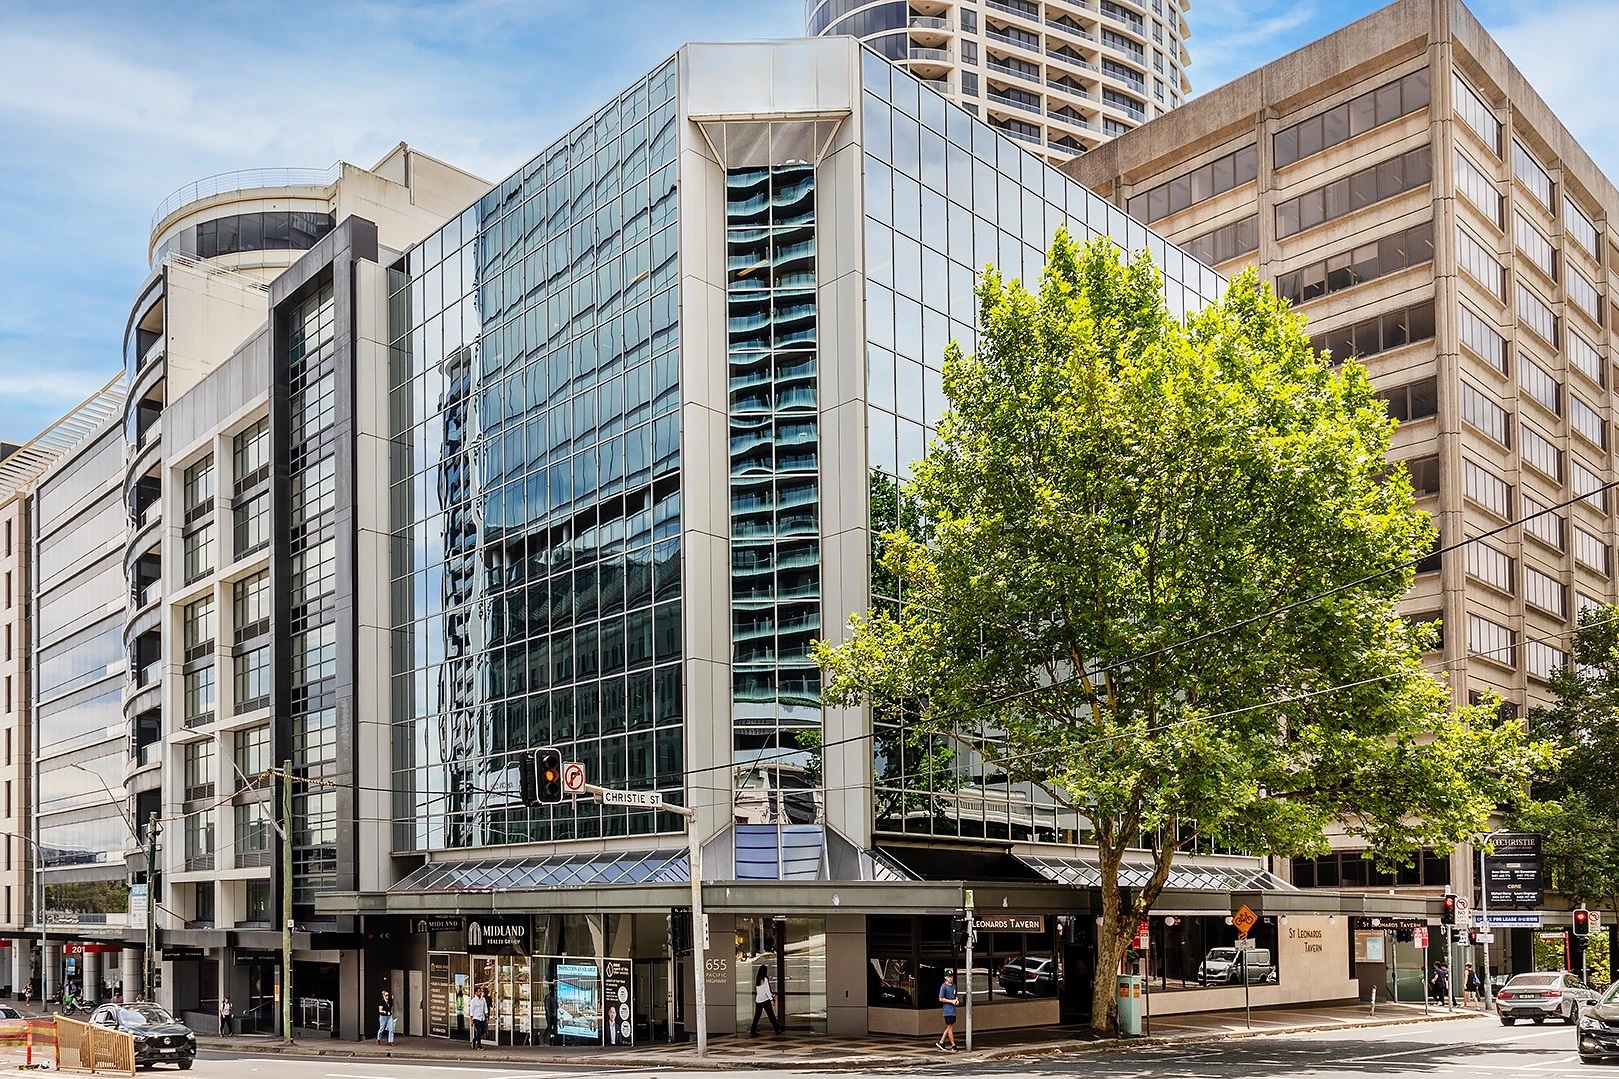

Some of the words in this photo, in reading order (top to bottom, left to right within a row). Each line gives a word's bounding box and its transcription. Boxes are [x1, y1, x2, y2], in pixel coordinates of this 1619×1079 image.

[605, 792, 646, 804] CHRISTIE
[650, 795, 660, 804] ST
[972, 919, 1008, 929] LEONARDS
[1009, 918, 1040, 929] TAVERN
[483, 925, 525, 936] MIDLAND
[1297, 927, 1322, 939] LEONARDS
[1304, 941, 1323, 952] TAVERN
[706, 959, 727, 970] 655
